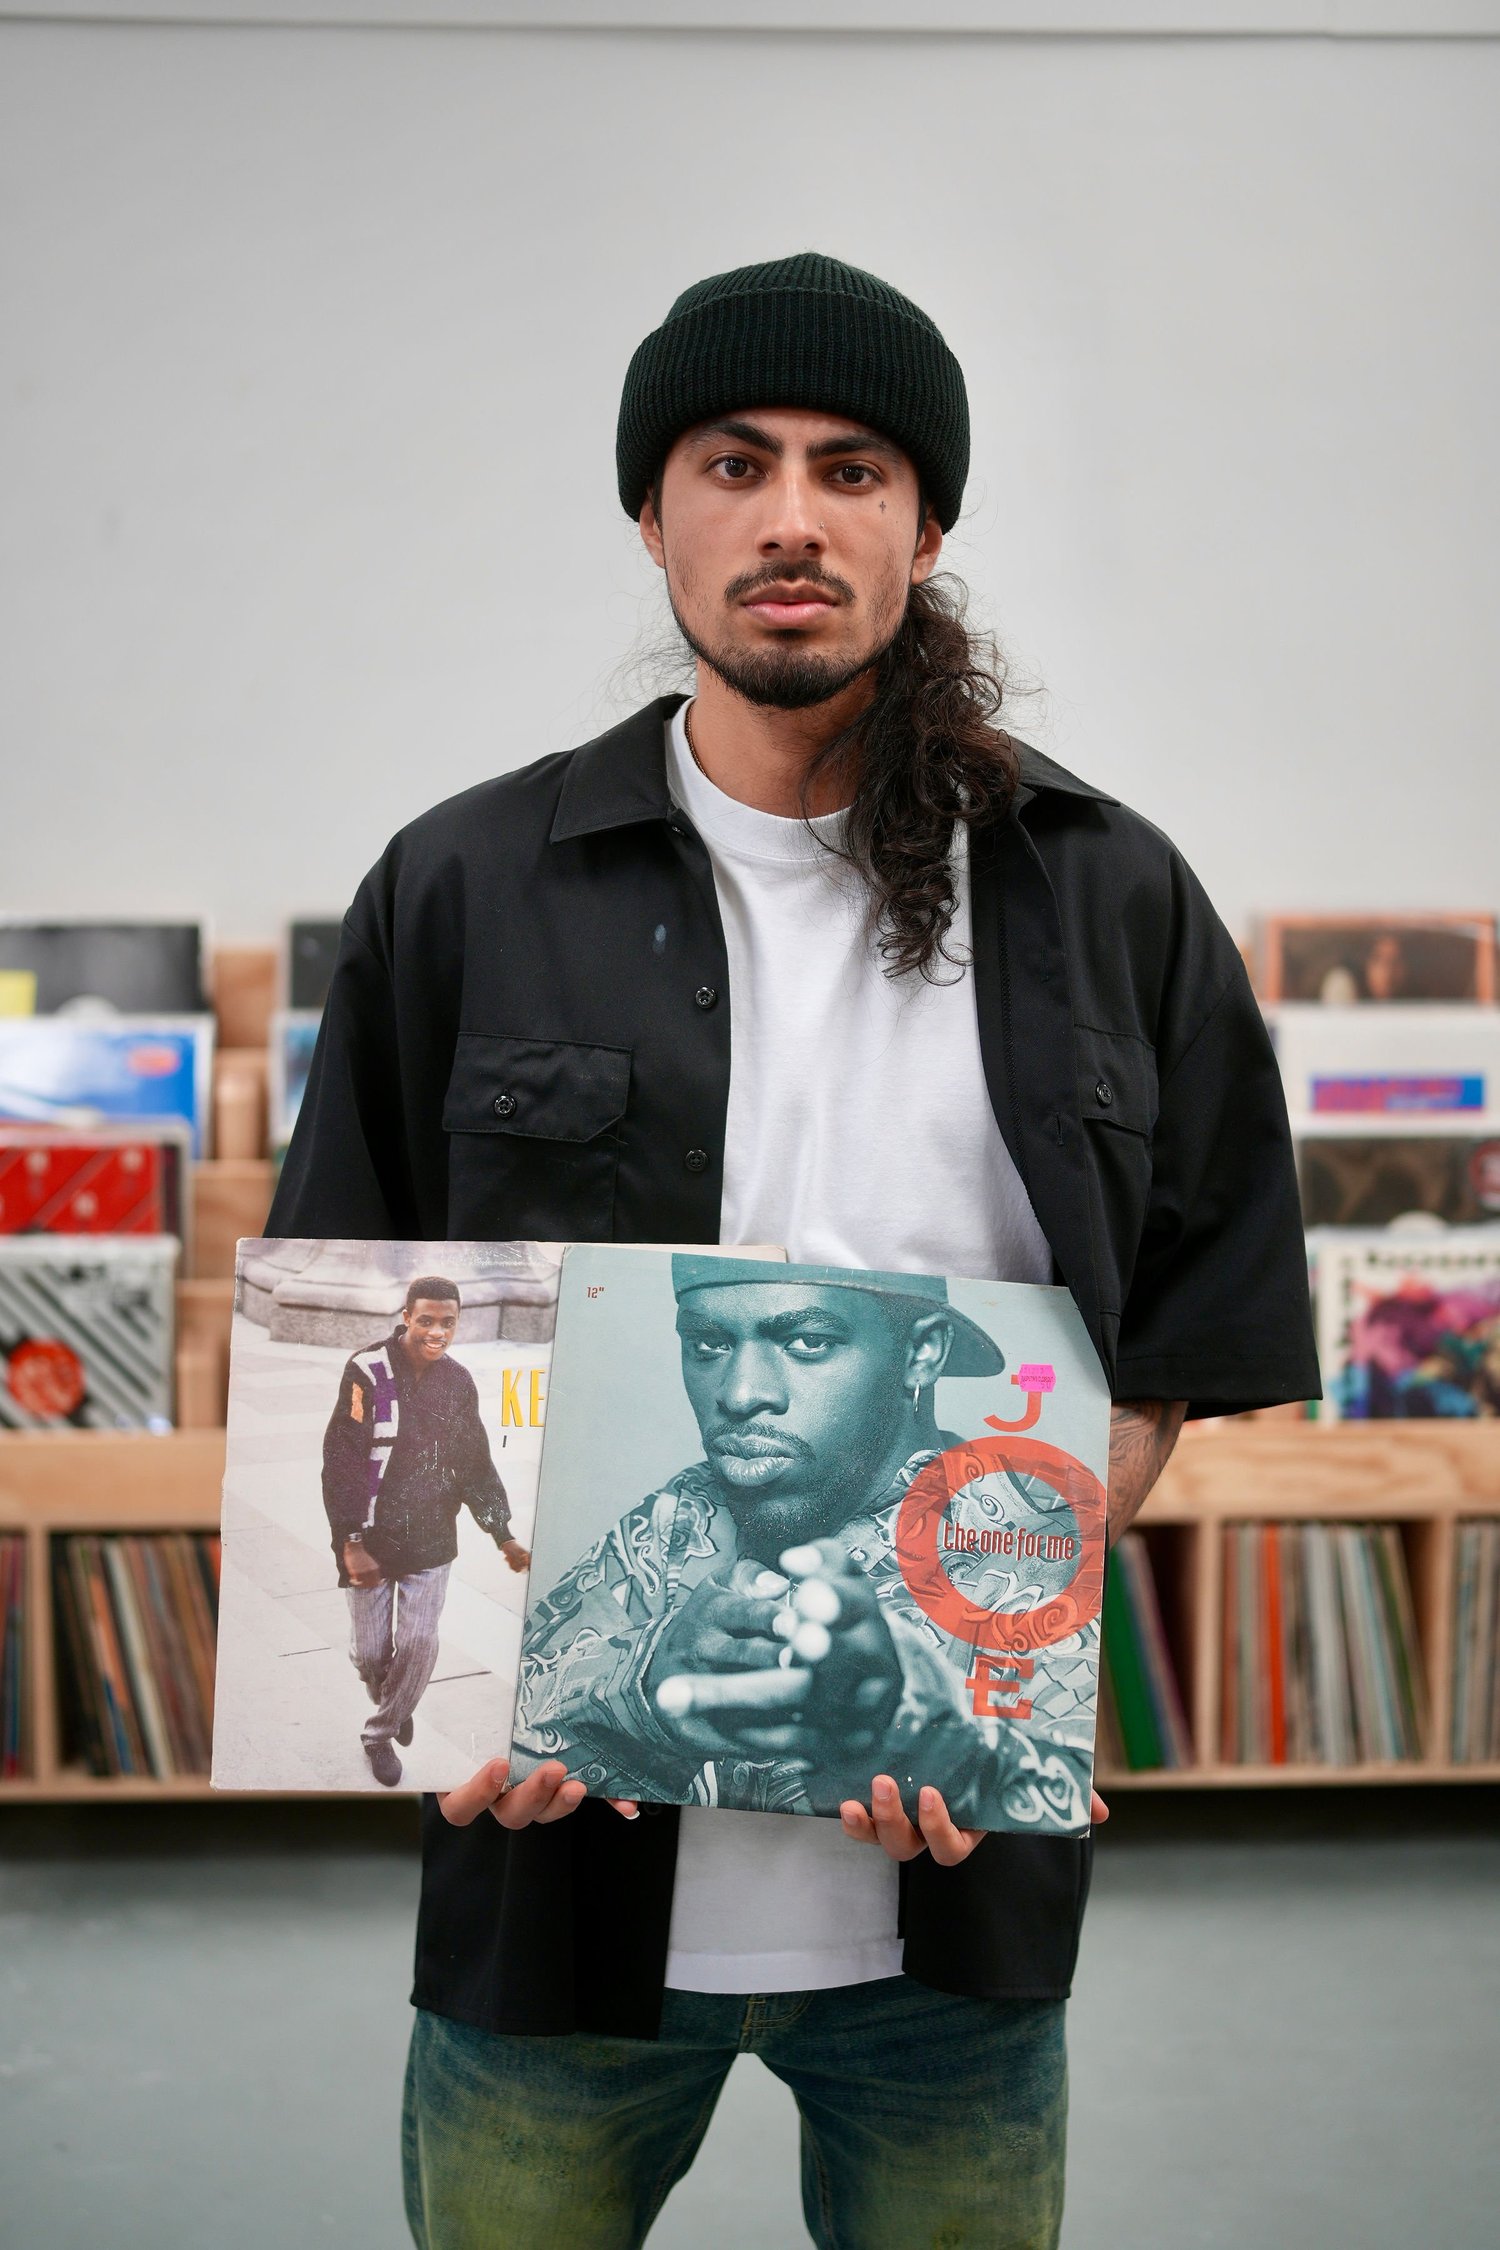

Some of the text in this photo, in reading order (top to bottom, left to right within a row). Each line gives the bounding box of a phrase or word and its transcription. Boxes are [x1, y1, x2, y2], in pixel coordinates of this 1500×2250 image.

[587, 1286, 604, 1298] 12"
[943, 1521, 1074, 1561] the one for me
